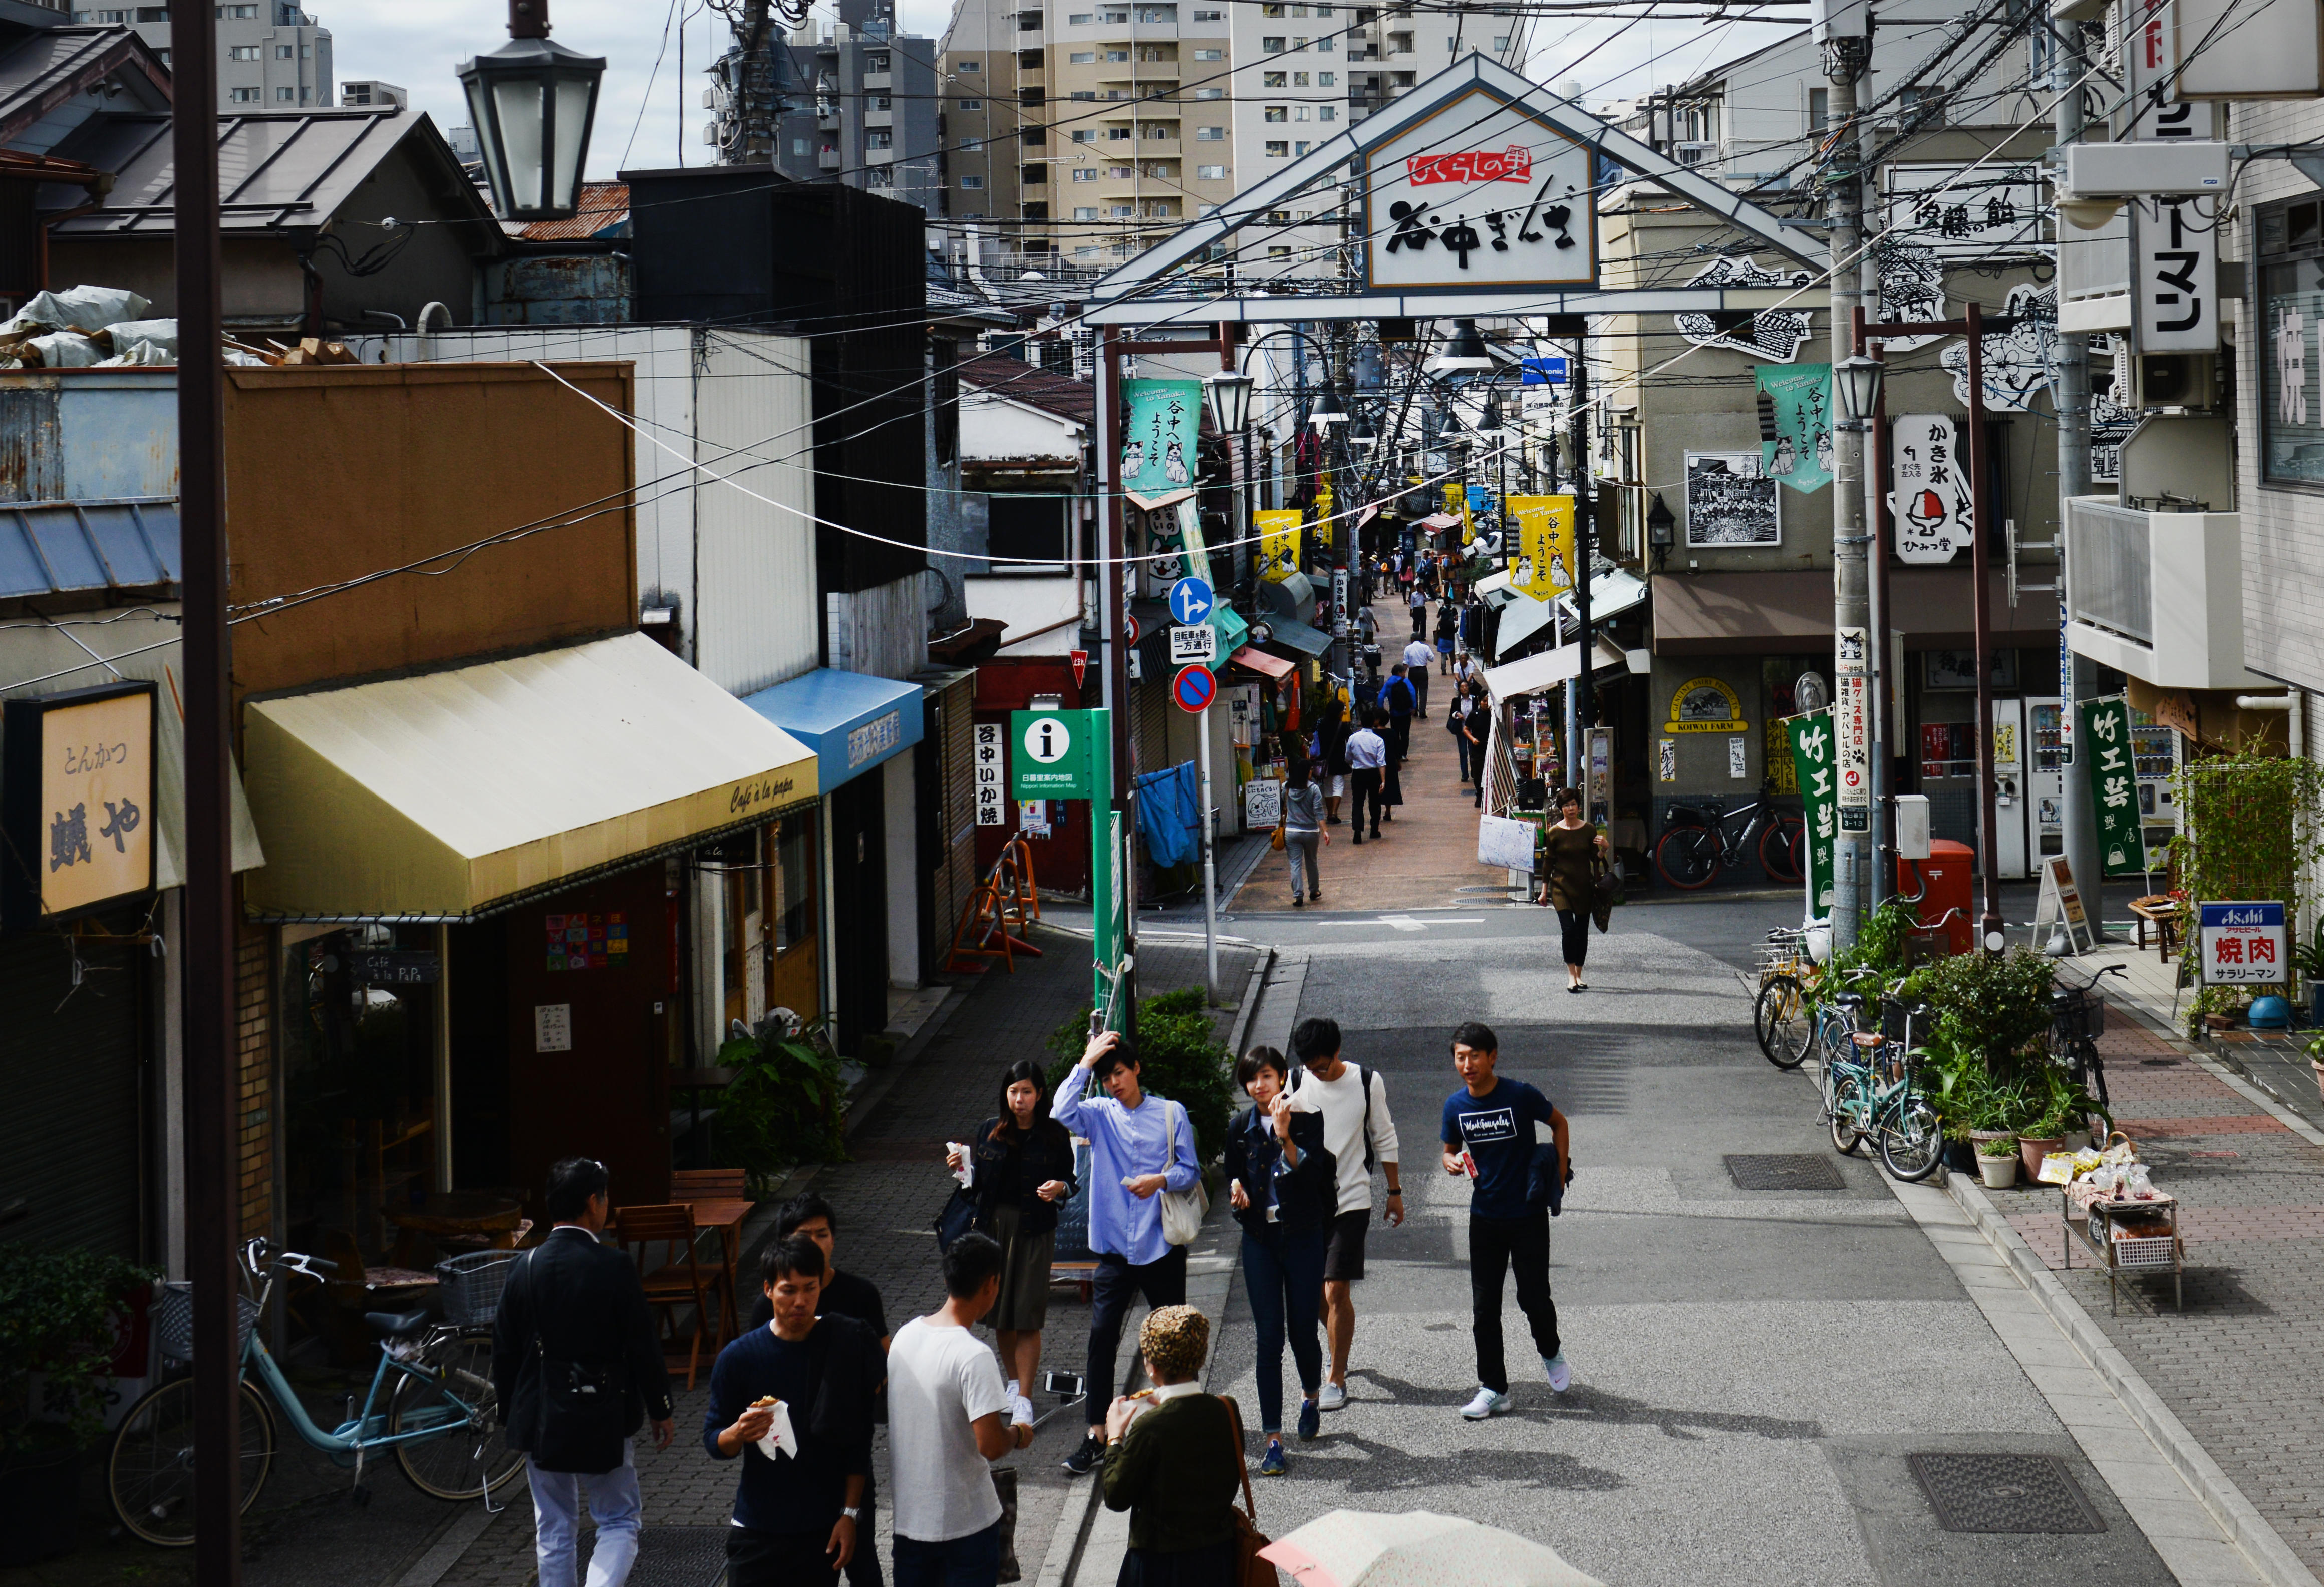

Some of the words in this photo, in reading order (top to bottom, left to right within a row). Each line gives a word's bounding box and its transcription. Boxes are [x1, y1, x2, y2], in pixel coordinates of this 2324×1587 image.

[1409, 145, 1532, 184] ひぐらしの里
[1386, 174, 1575, 269] 谷中ぎんざ
[1909, 187, 2015, 239] 後藤の飴
[1133, 388, 1168, 399] Welcome
[1156, 390, 1186, 400] Yanaka
[1770, 375, 1806, 388] Welcome
[1796, 377, 1823, 388] Yanaka
[1166, 400, 1184, 441] 谷中へ
[1807, 387, 1826, 429] 谷中へ
[1148, 412, 1161, 466] ようこそ
[1796, 402, 1810, 460] ようこそ
[1929, 424, 1948, 484] かき氷
[1259, 517, 1281, 525] Welcome
[1517, 505, 1545, 516] Welcome
[1540, 507, 1563, 517] Yanaka
[1547, 517, 1560, 552] 谷中へ
[1902, 537, 1951, 552] ひみつ堂
[1537, 533, 1547, 581] ようこそ
[1174, 630, 1211, 640] 自転車を除く
[1174, 640, 1211, 651] 一方通行
[1673, 682, 1692, 711] GENUINE
[1692, 678, 1712, 687] DAIRY
[1715, 680, 1739, 711] PRODUCTS
[1852, 677, 1863, 745] 猫グッズ専門店
[1840, 677, 1851, 768] 猫雑貨・アパレルの店
[65, 742, 127, 775] とんかつ
[978, 725, 998, 824] 谷中いか焼
[2094, 710, 2130, 807] 竹工芸
[1023, 774, 1072, 782] 日暮里案内地図
[1800, 725, 1833, 839] 竹工芸
[730, 783, 751, 814] Café
[754, 783, 760, 801] à
[762, 784, 770, 799] la
[772, 777, 793, 802] papa
[50, 797, 140, 873] 蟻や
[1740, 818, 1757, 841] TREK
[2221, 909, 2263, 925] Asahi
[367, 956, 389, 968] Café
[2216, 936, 2276, 964] 焼肉
[373, 969, 379, 980] à
[384, 971, 392, 981] la
[399, 967, 421, 982] PaPa
[2215, 969, 2276, 979] サラリーマン
